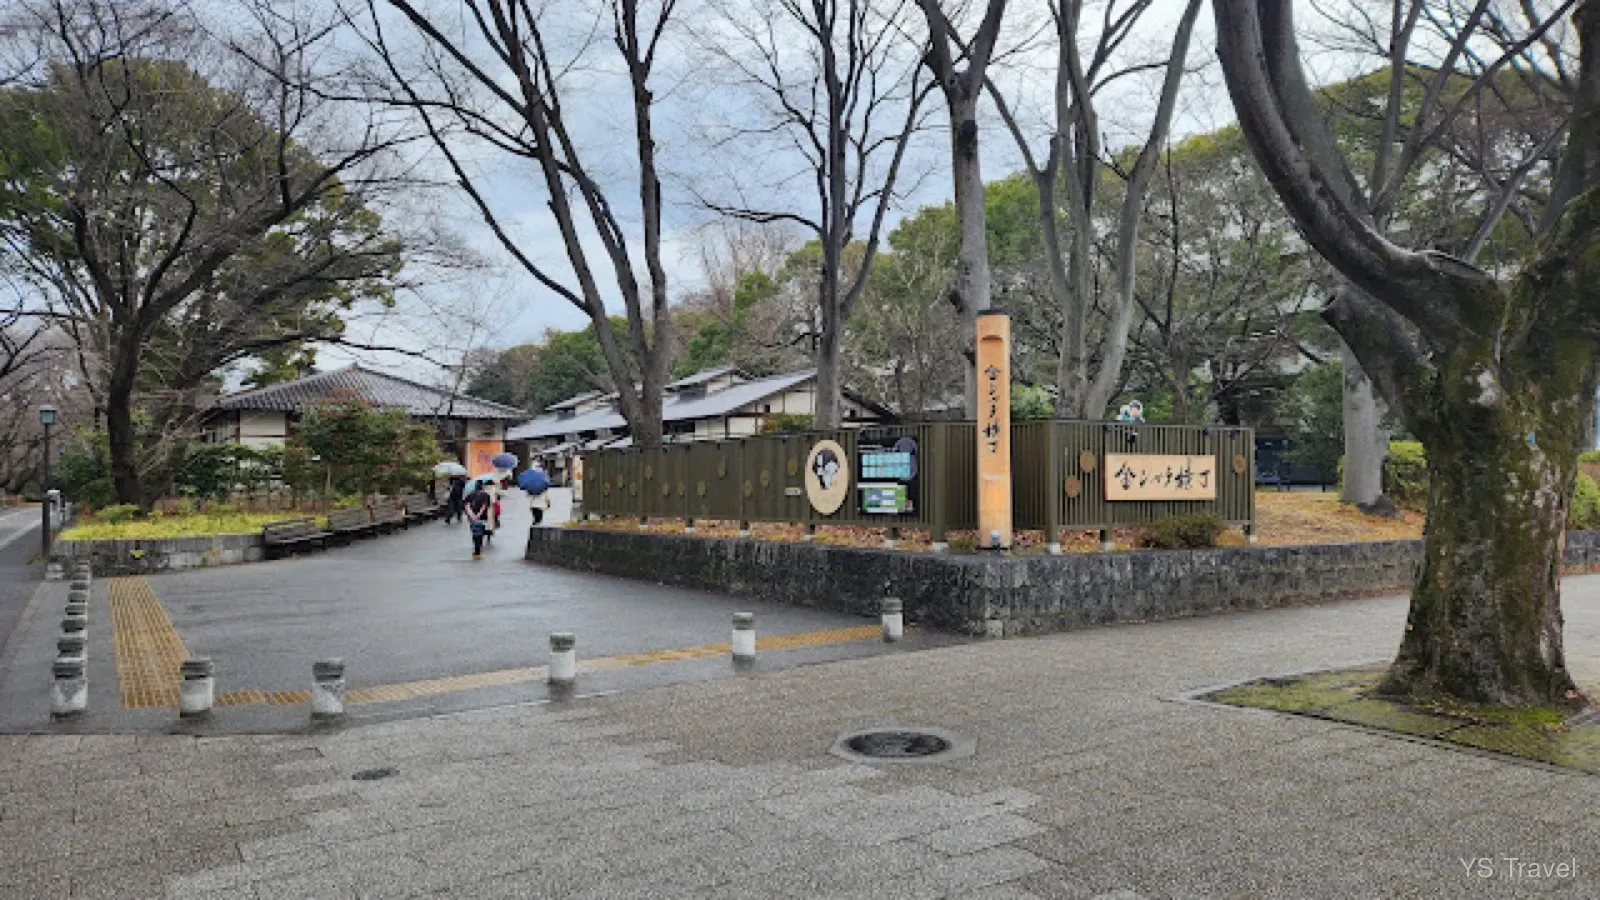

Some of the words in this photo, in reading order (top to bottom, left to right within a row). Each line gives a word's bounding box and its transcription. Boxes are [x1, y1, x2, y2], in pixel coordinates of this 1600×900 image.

[1114, 458, 1211, 492] 金シャチ横丁
